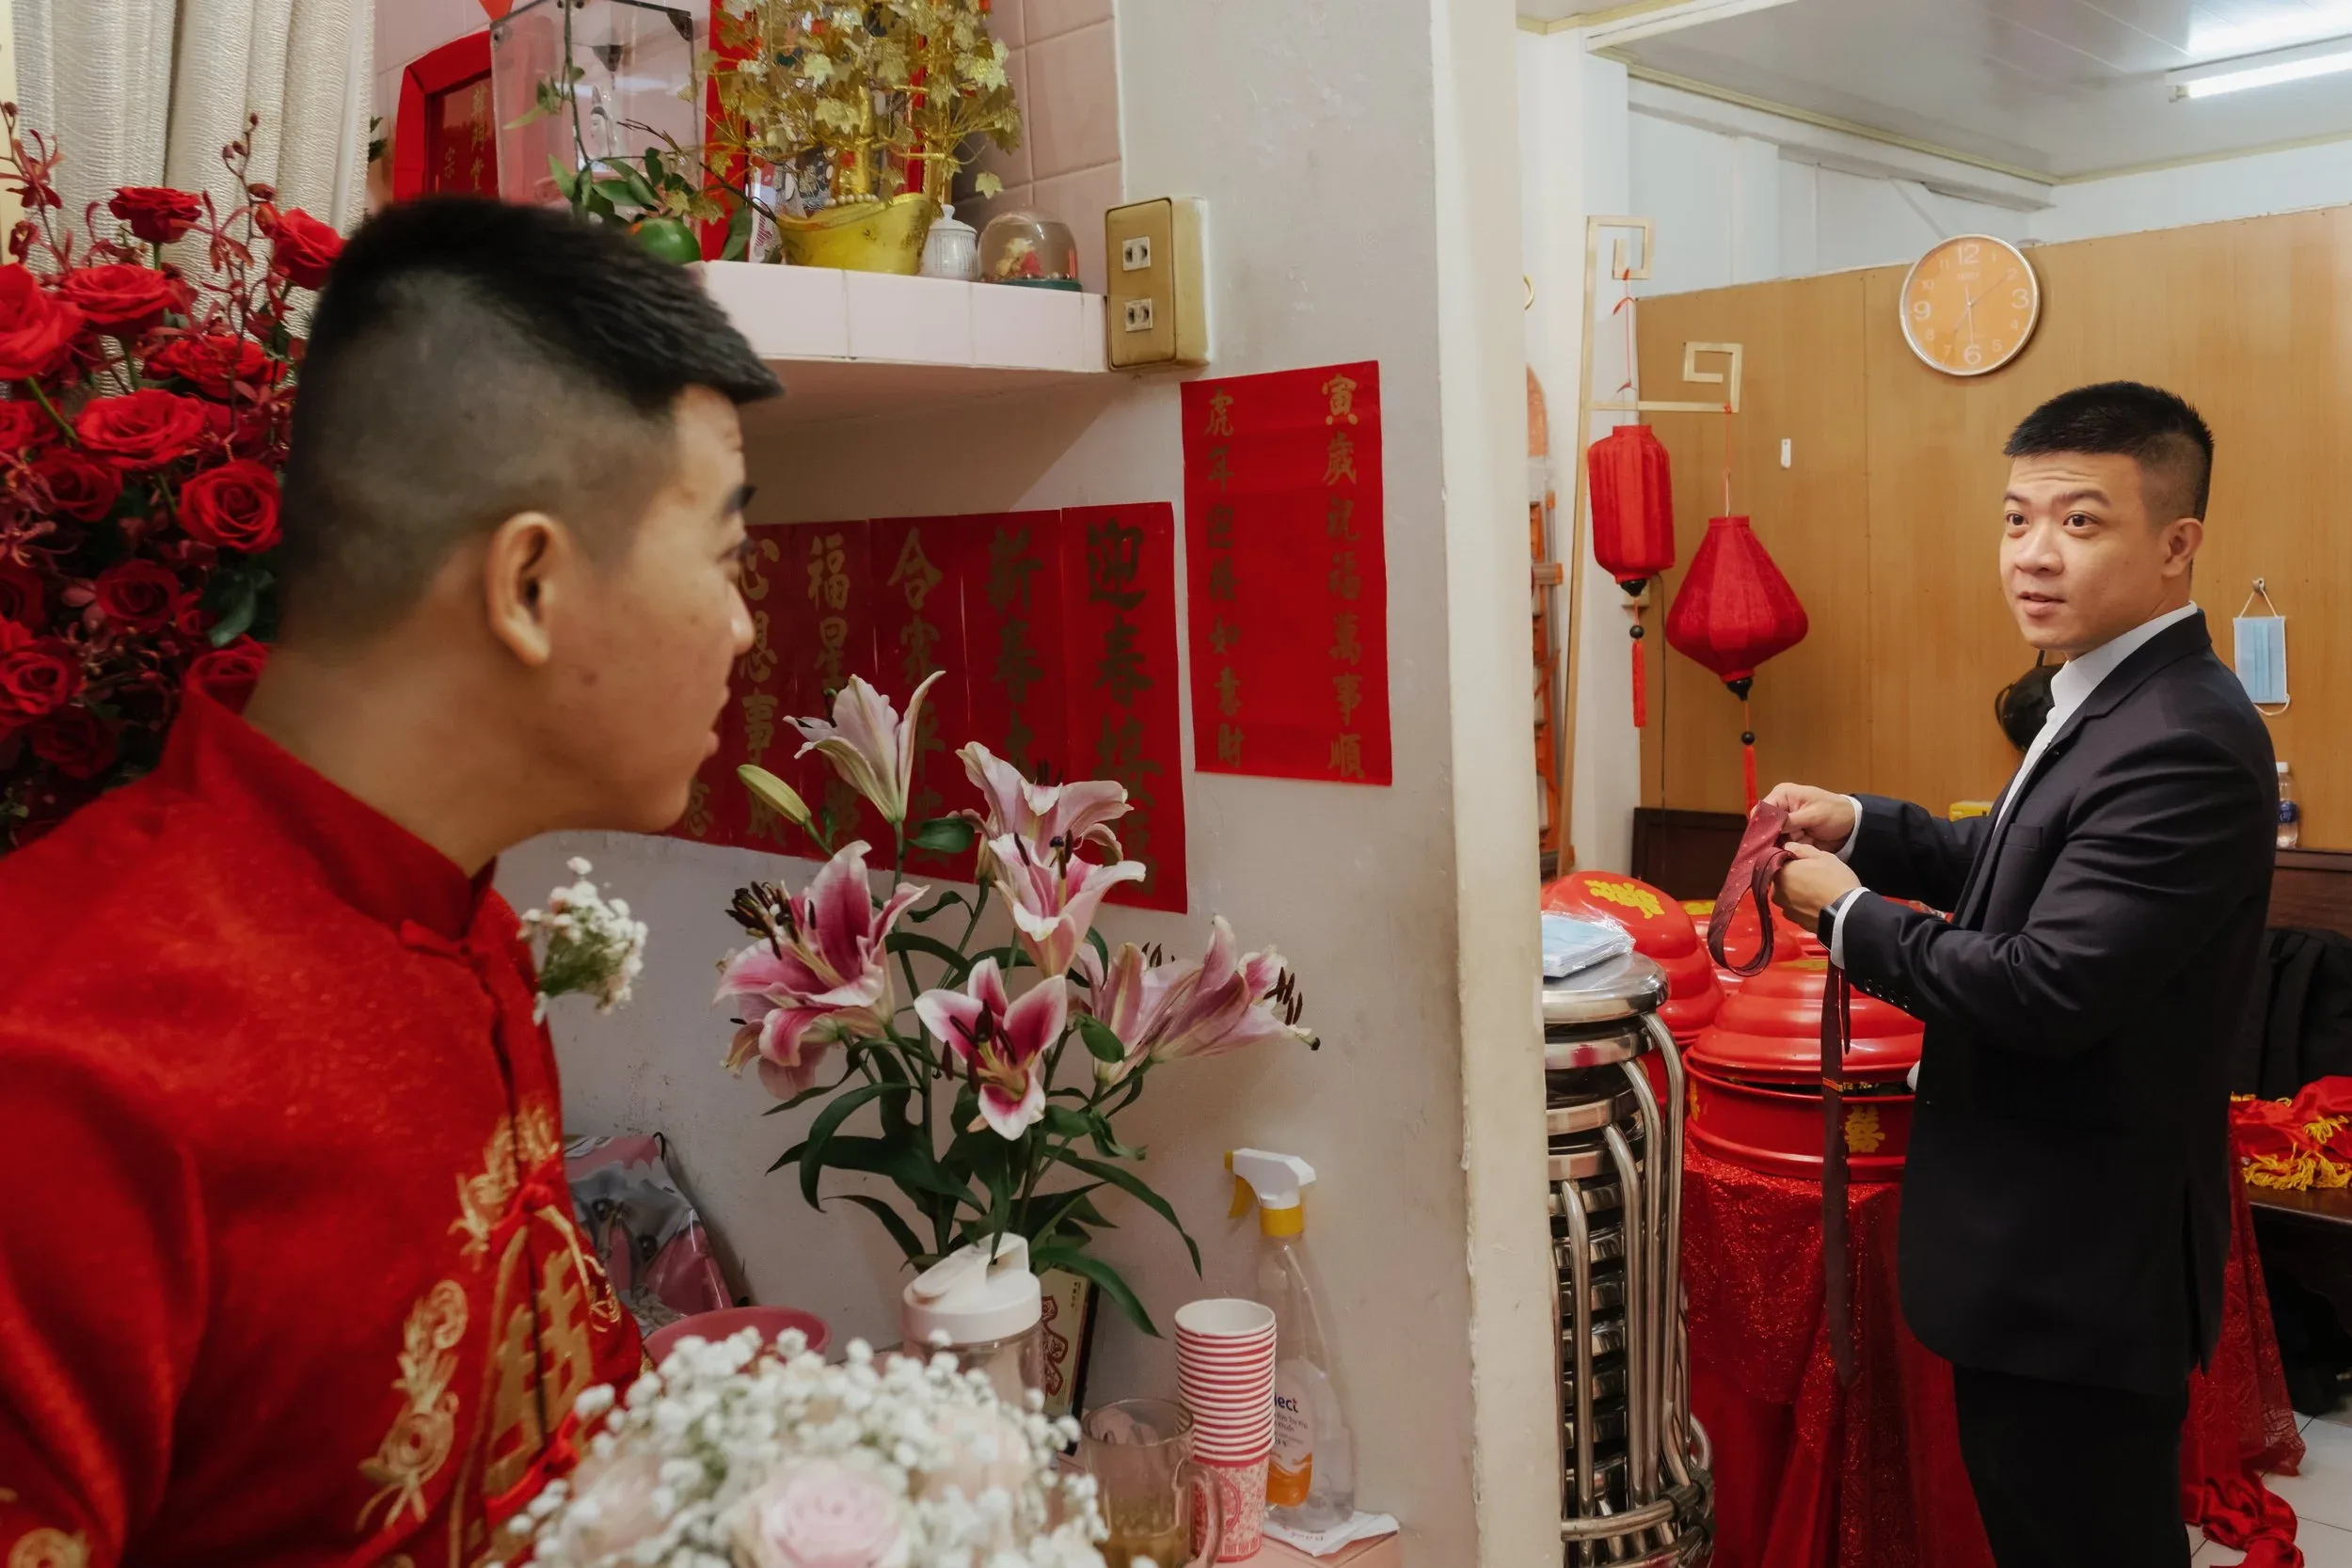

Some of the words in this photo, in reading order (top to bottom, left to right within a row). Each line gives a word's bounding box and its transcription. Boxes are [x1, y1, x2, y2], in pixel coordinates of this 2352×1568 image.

[1958, 244, 1980, 264] 12
[1940, 259, 1949, 270] 11
[2007, 268, 2018, 280] 2
[1922, 279, 1934, 290] 10
[2011, 288, 2029, 309] 3
[1914, 300, 1931, 321] 9
[1943, 345, 1952, 359] 7
[1992, 340, 2002, 353] 5
[1963, 344, 1981, 365] 6
